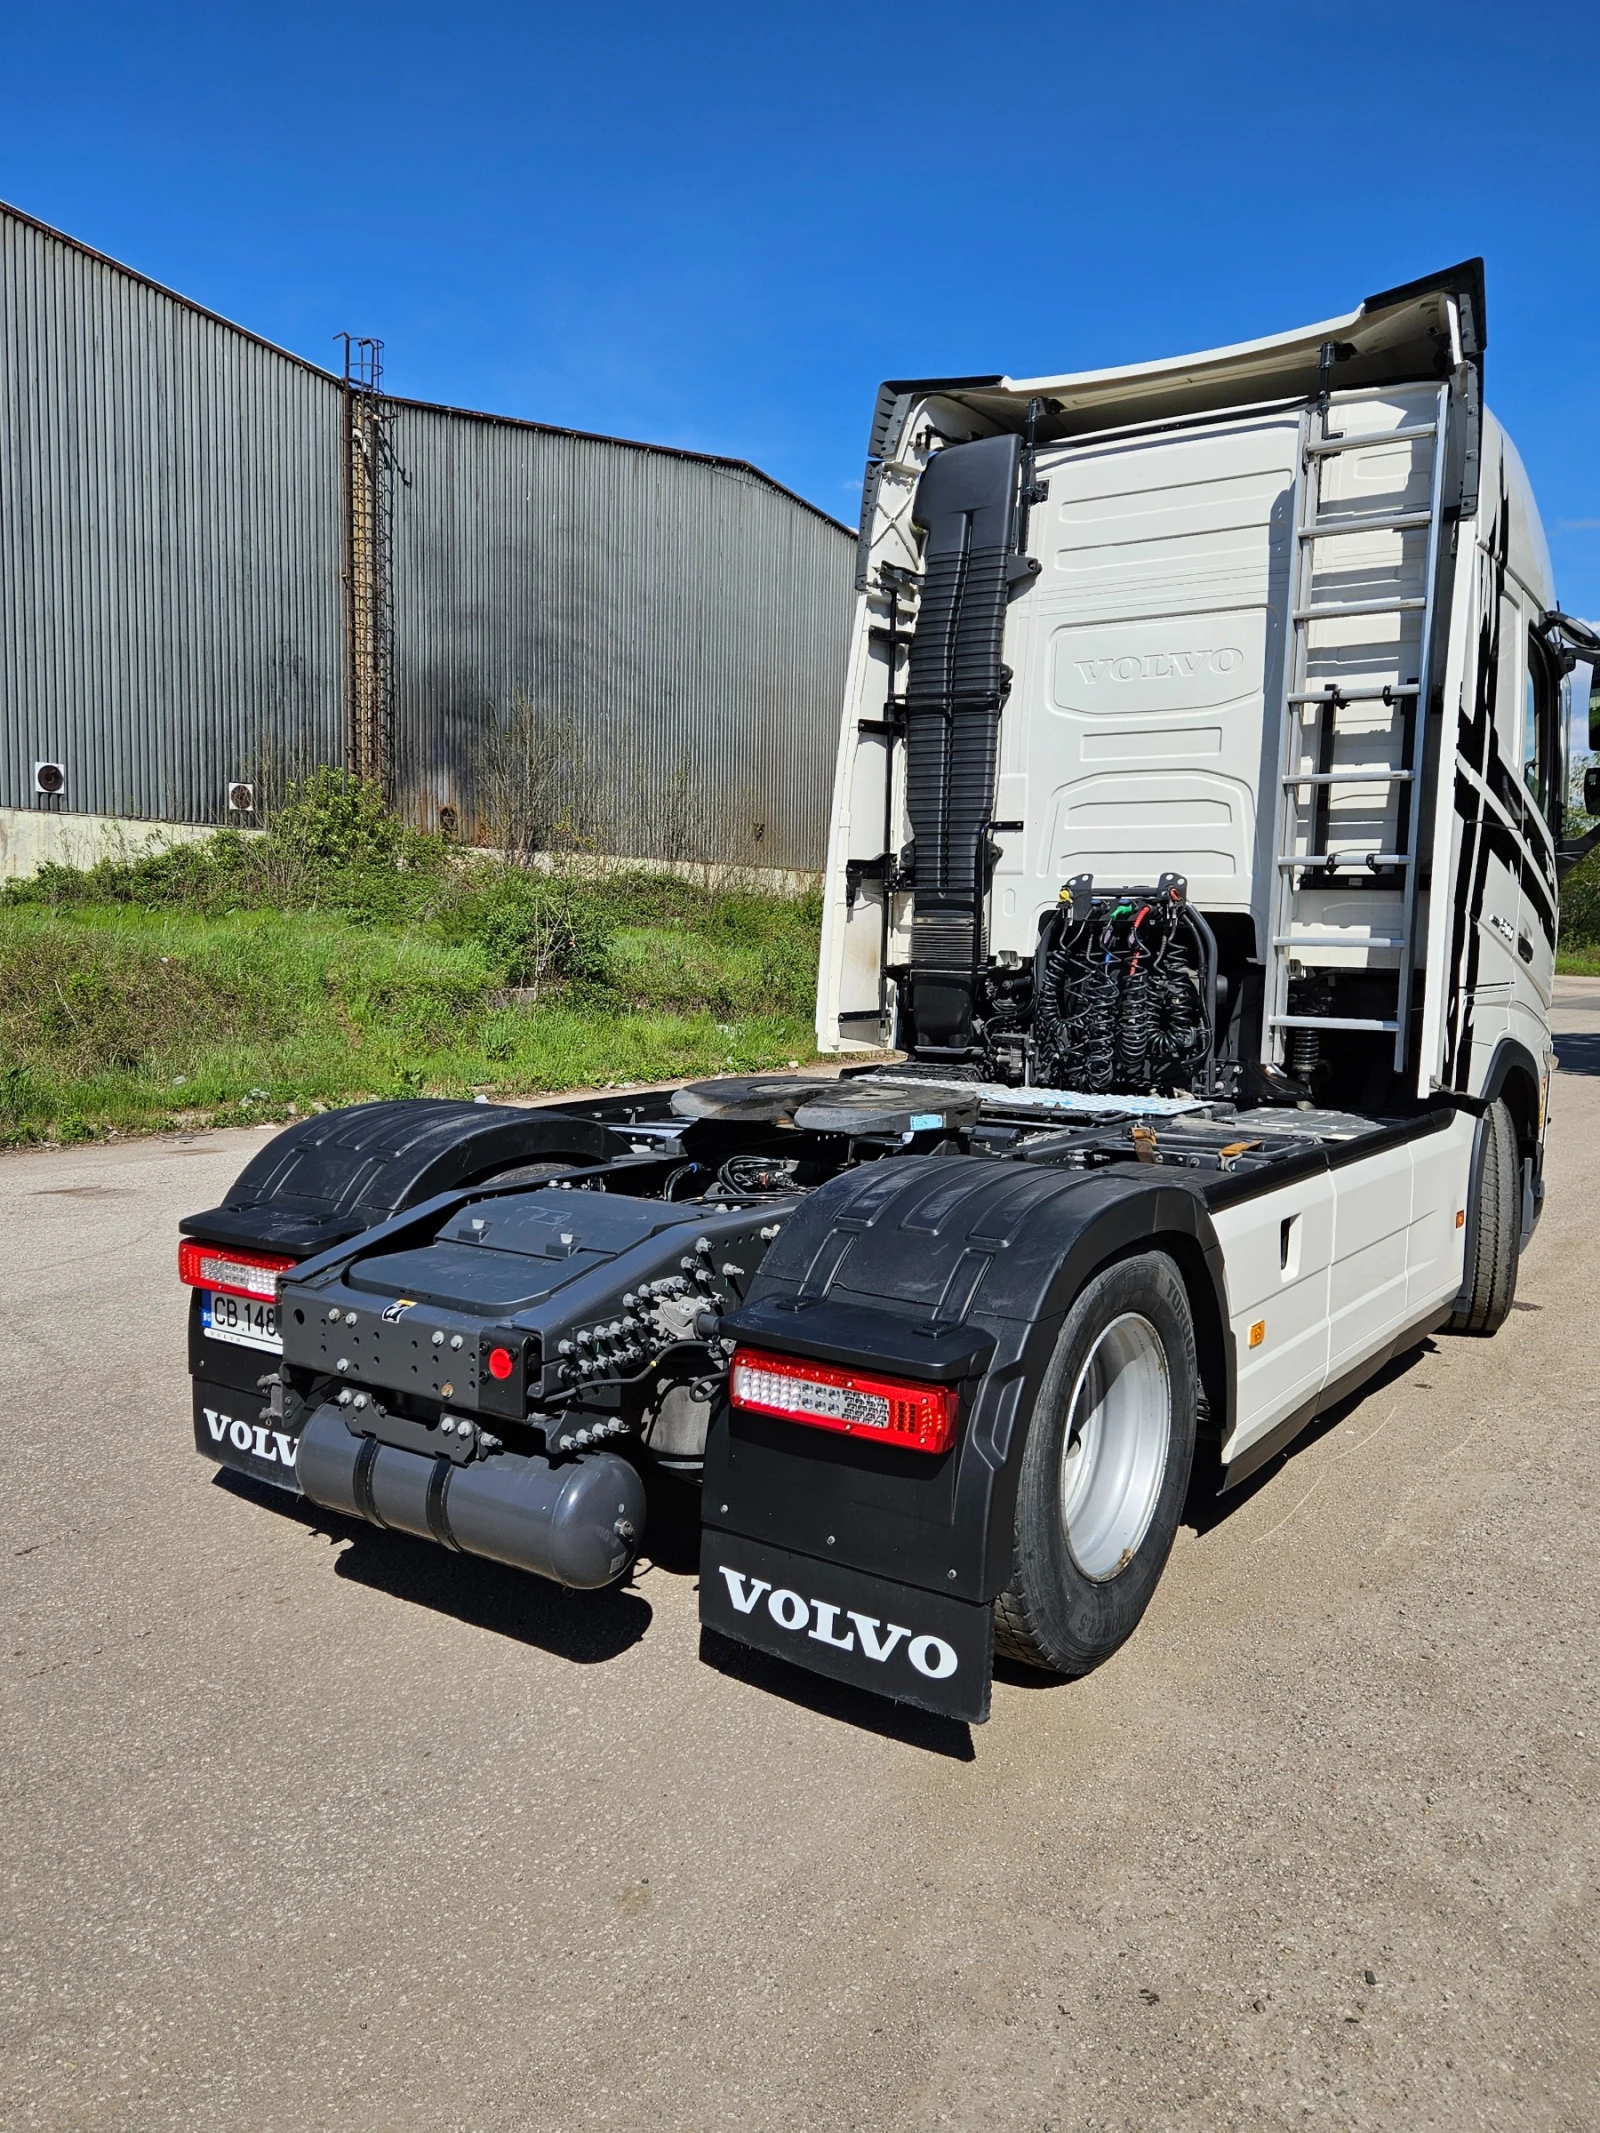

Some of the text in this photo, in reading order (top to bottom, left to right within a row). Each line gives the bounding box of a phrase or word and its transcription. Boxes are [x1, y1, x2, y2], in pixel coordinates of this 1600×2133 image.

[1074, 648, 1244, 684] VOLVO
[210, 1330, 241, 1343] VOLVO
[214, 1297, 282, 1338] CB 148
[1166, 1277, 1196, 1375] TORQUE
[203, 1408, 300, 1468] VOLV
[718, 1565, 959, 1679] VOLVO
